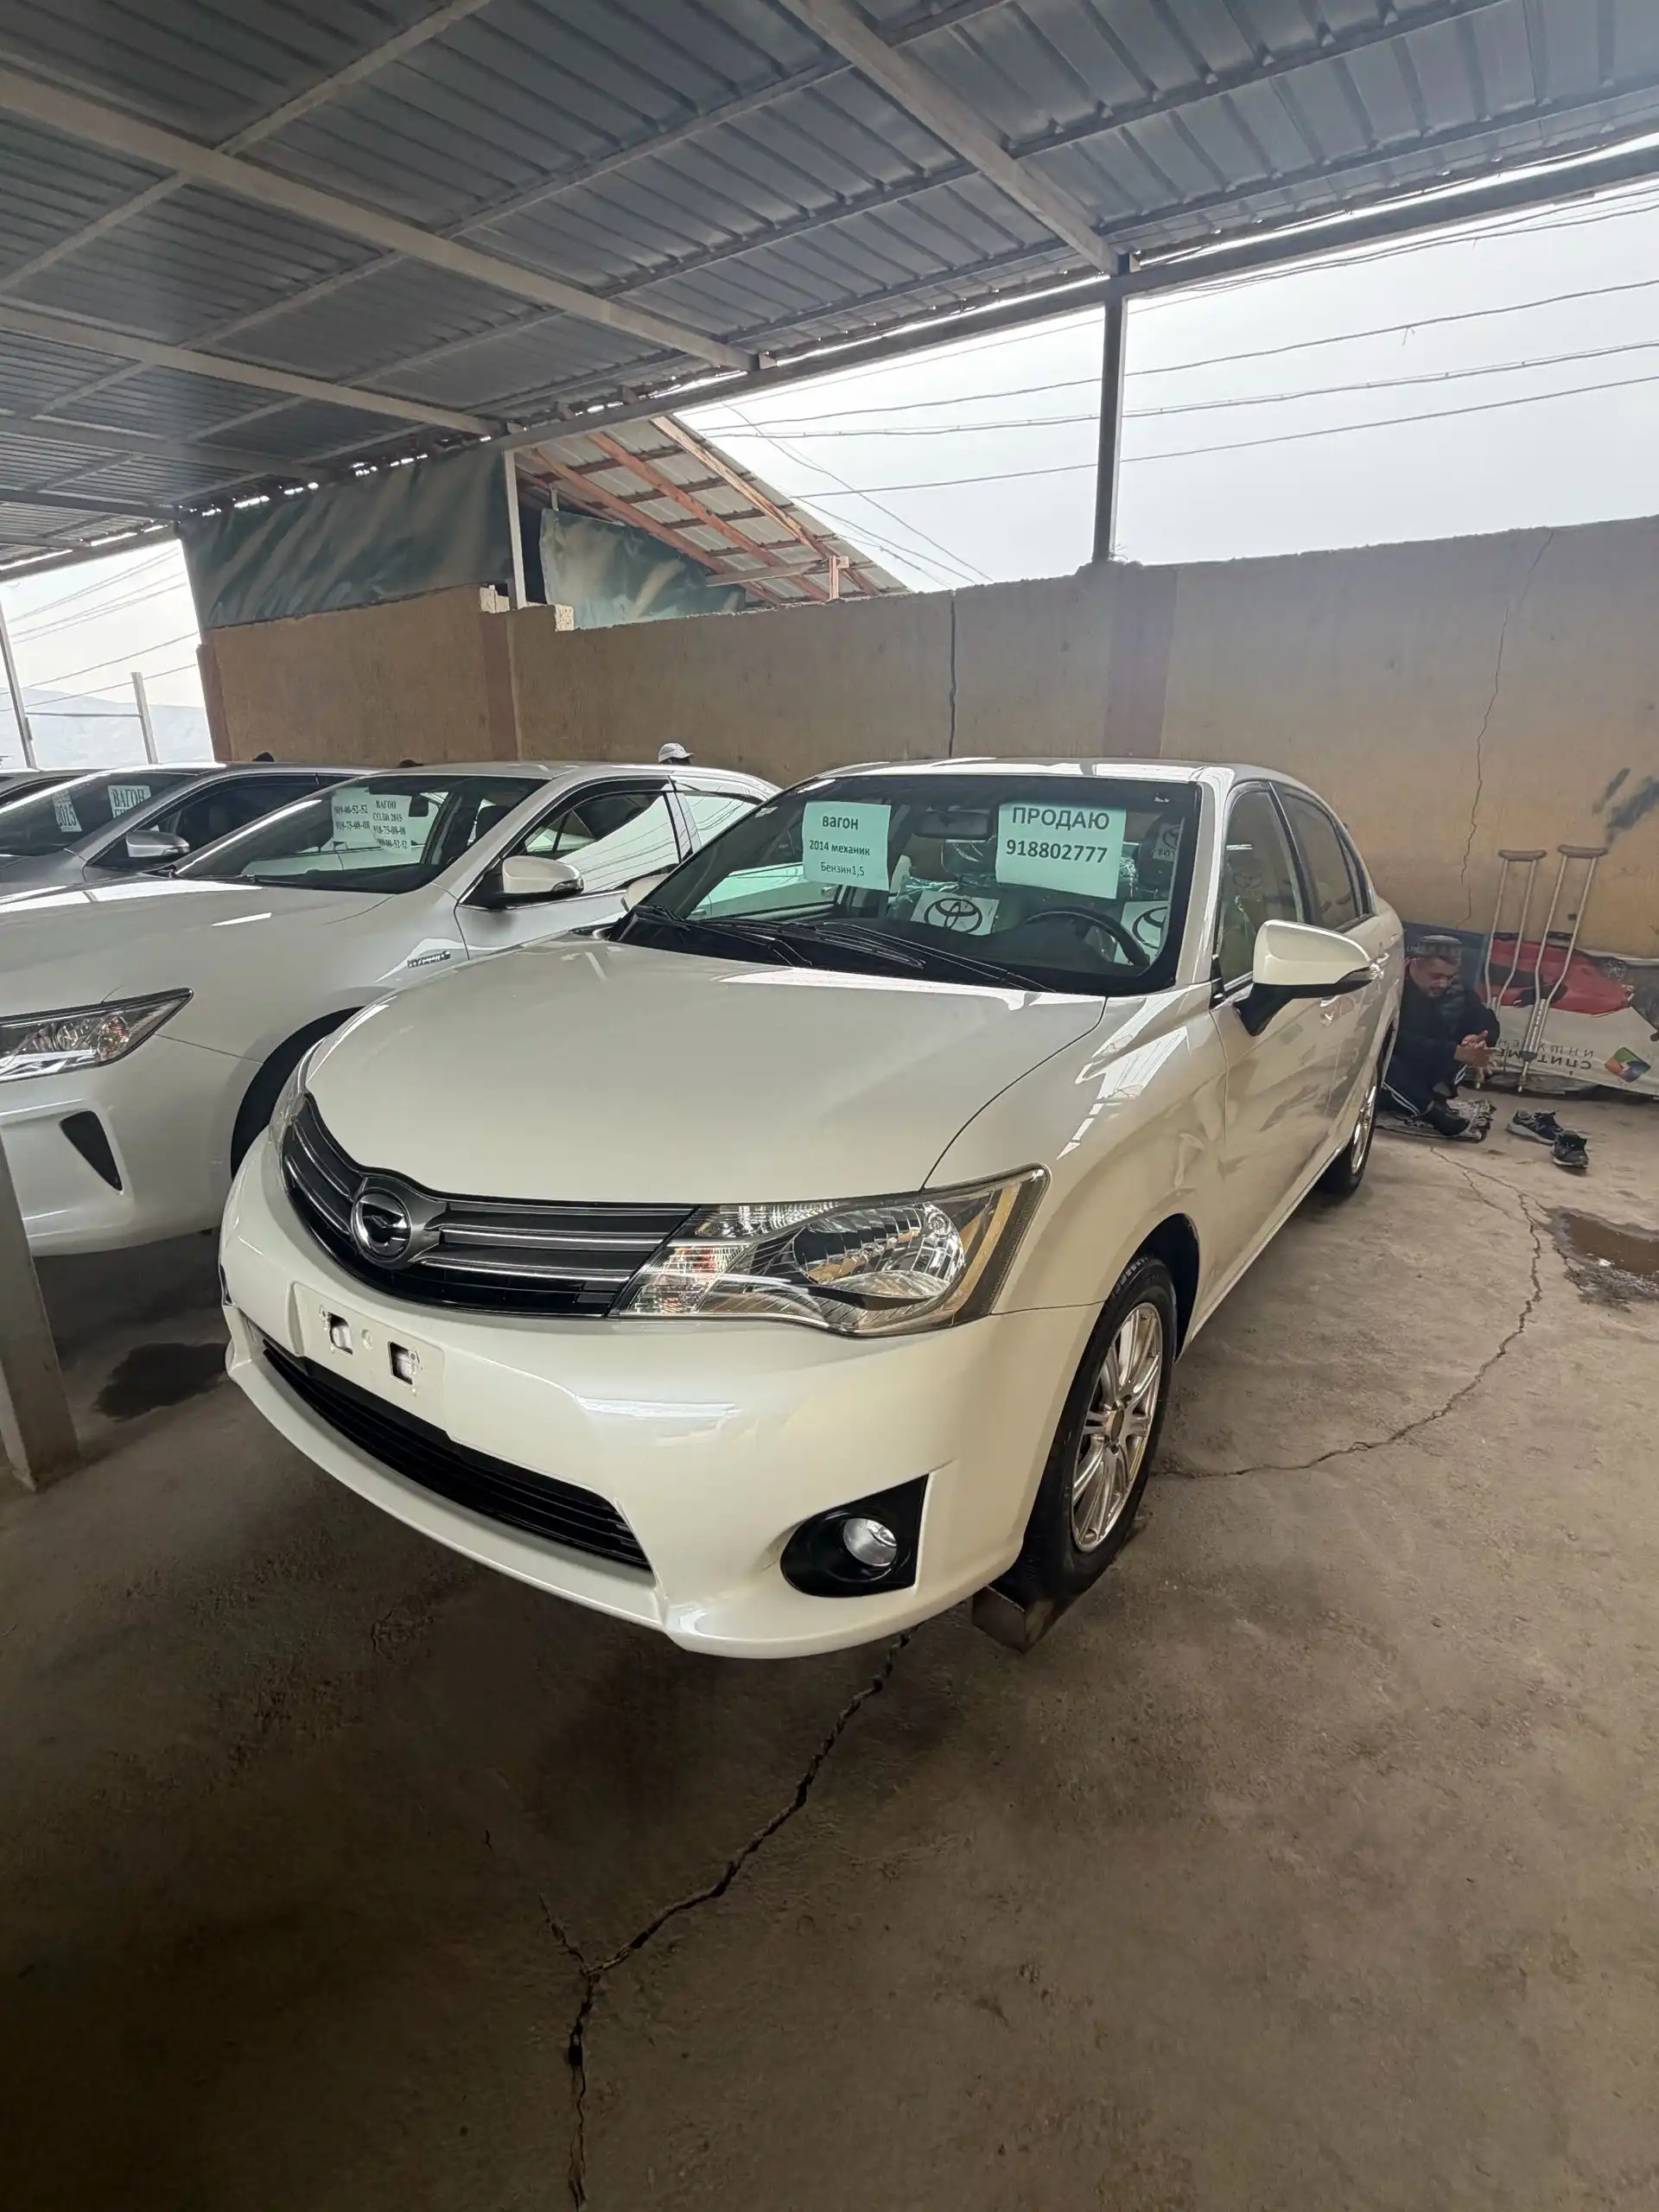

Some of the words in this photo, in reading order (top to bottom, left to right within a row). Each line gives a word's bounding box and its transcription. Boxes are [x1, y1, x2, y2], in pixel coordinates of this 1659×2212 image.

[376, 800, 397, 810] ВАГОН
[822, 816, 859, 830] вагон
[1012, 807, 1110, 831] ПРОДАЮ
[809, 840, 830, 851] 2014
[830, 844, 870, 855] механик
[1006, 839, 1108, 863] 918802777
